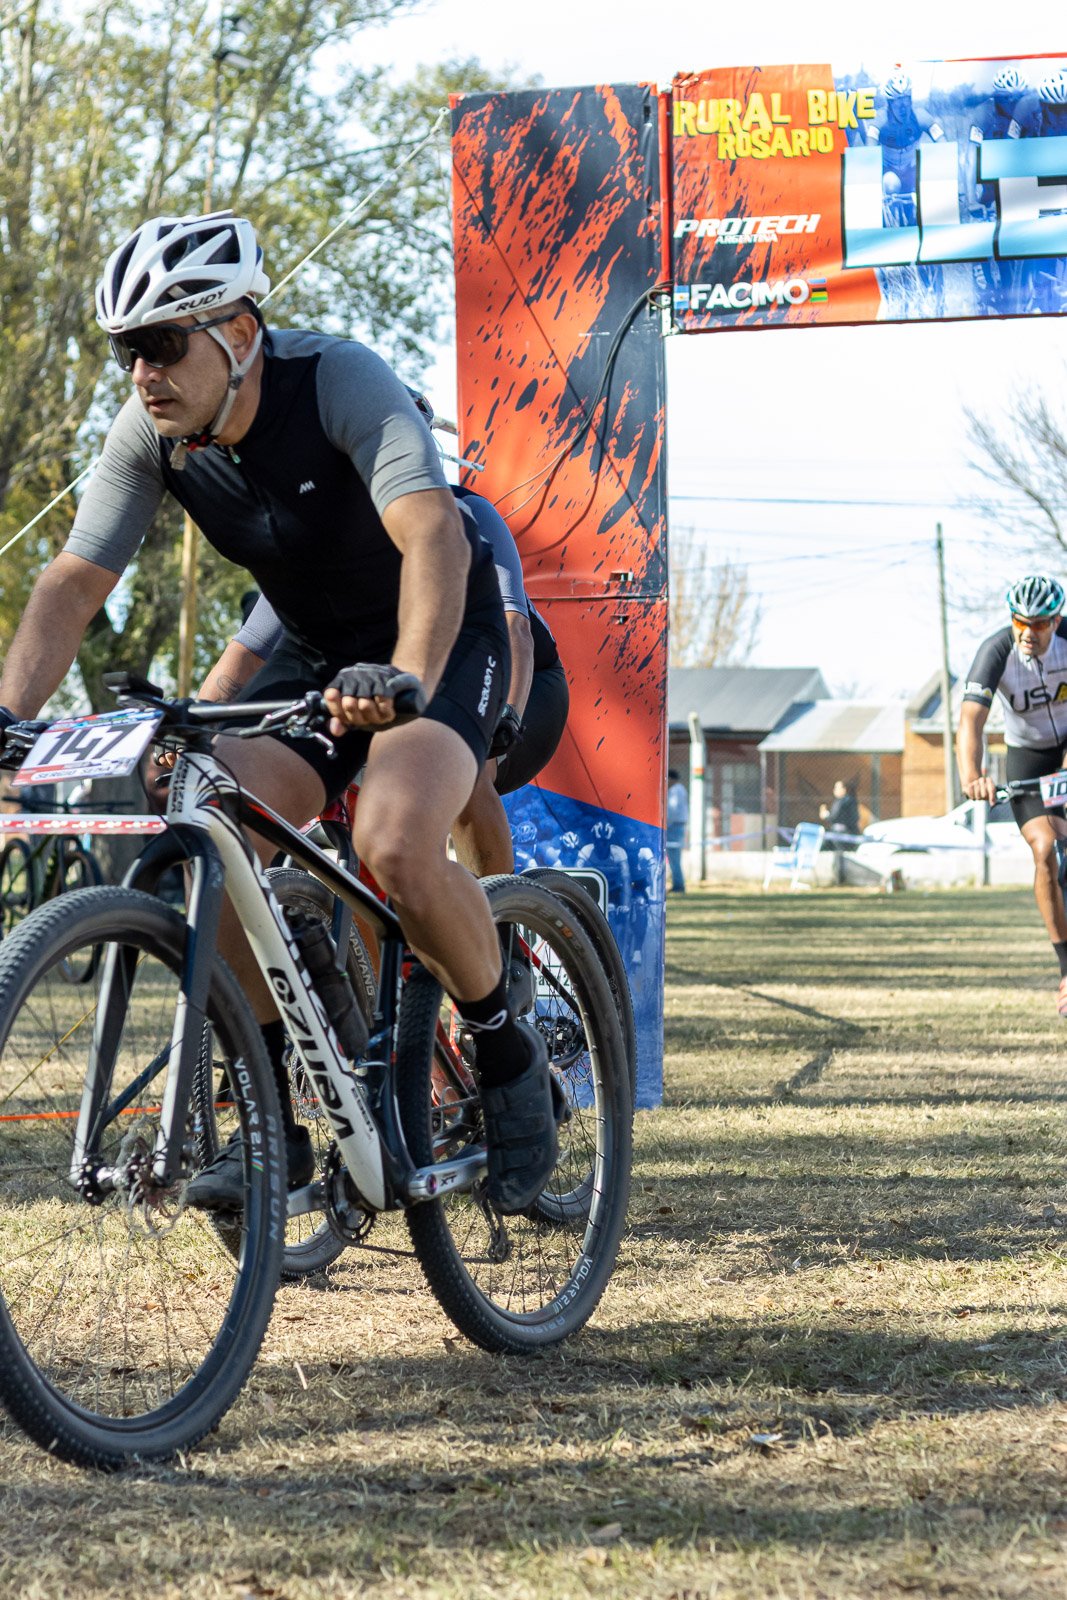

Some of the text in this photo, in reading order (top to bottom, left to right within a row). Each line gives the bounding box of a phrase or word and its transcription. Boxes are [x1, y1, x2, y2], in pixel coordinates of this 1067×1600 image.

[673, 86, 877, 137] RURAL BIKE
[717, 126, 834, 160] ROSARIO
[673, 214, 821, 238] PROTECH
[715, 233, 778, 244] ARGENTINA
[175, 288, 227, 312] RUDY
[690, 279, 810, 310] FACIMO
[38, 722, 141, 765] 147
[234, 1057, 259, 1126] VOLAR
[567, 1258, 593, 1298] VOLAR
